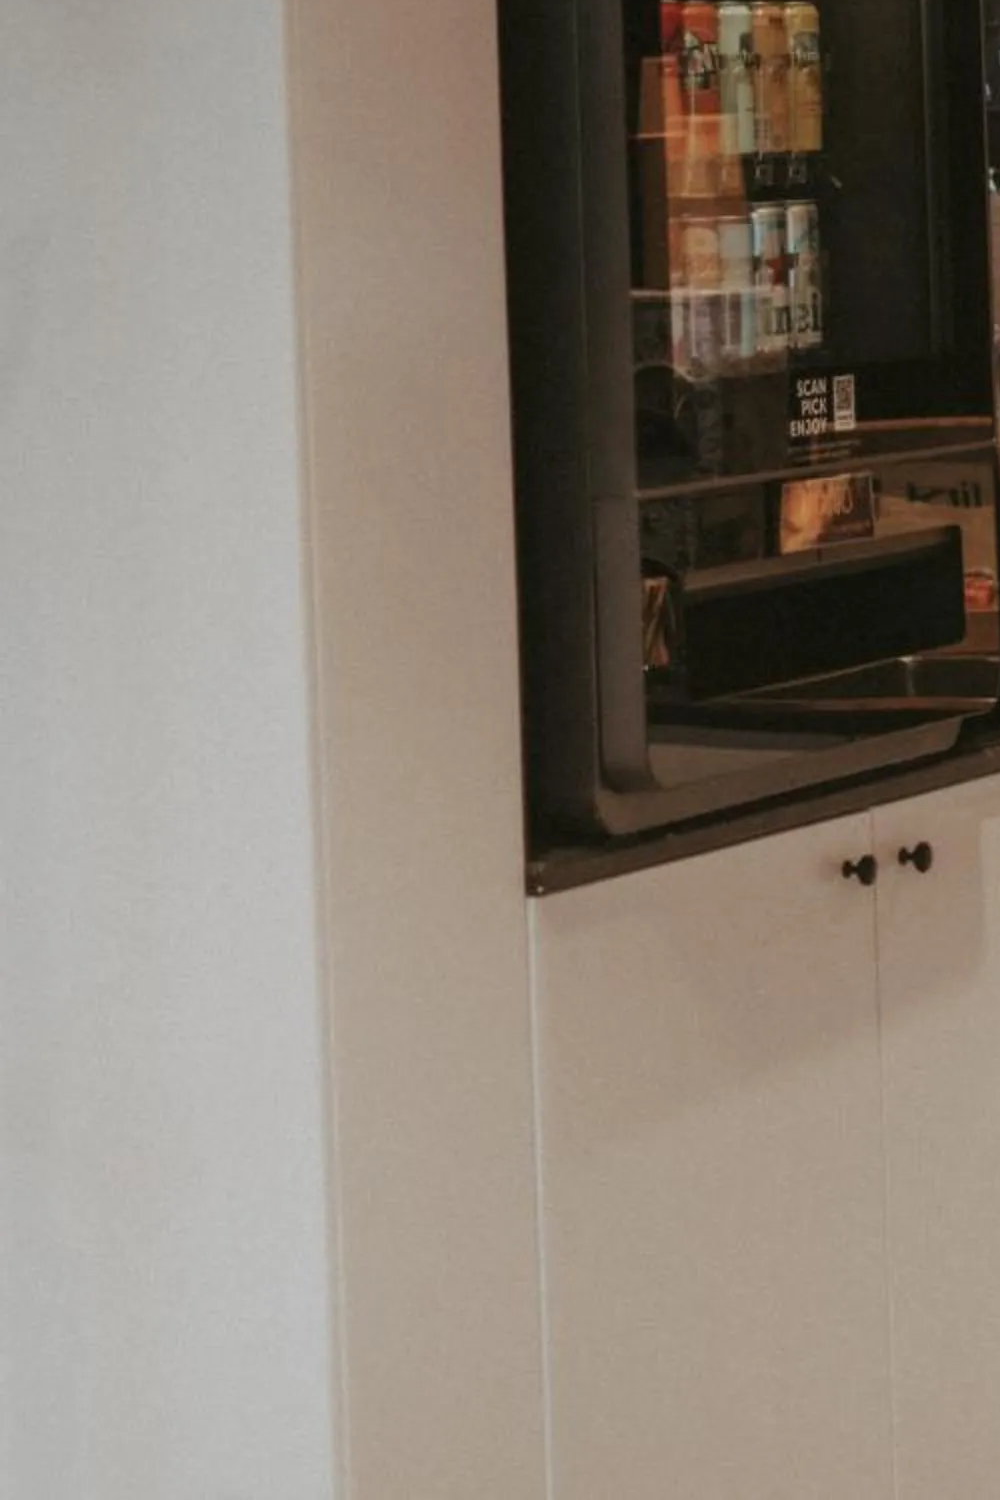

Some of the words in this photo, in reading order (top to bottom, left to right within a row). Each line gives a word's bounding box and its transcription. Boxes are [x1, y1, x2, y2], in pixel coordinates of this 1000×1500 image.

[796, 376, 827, 397] SCAN
[800, 398, 828, 416] PICK
[790, 417, 828, 437] ENJOY
